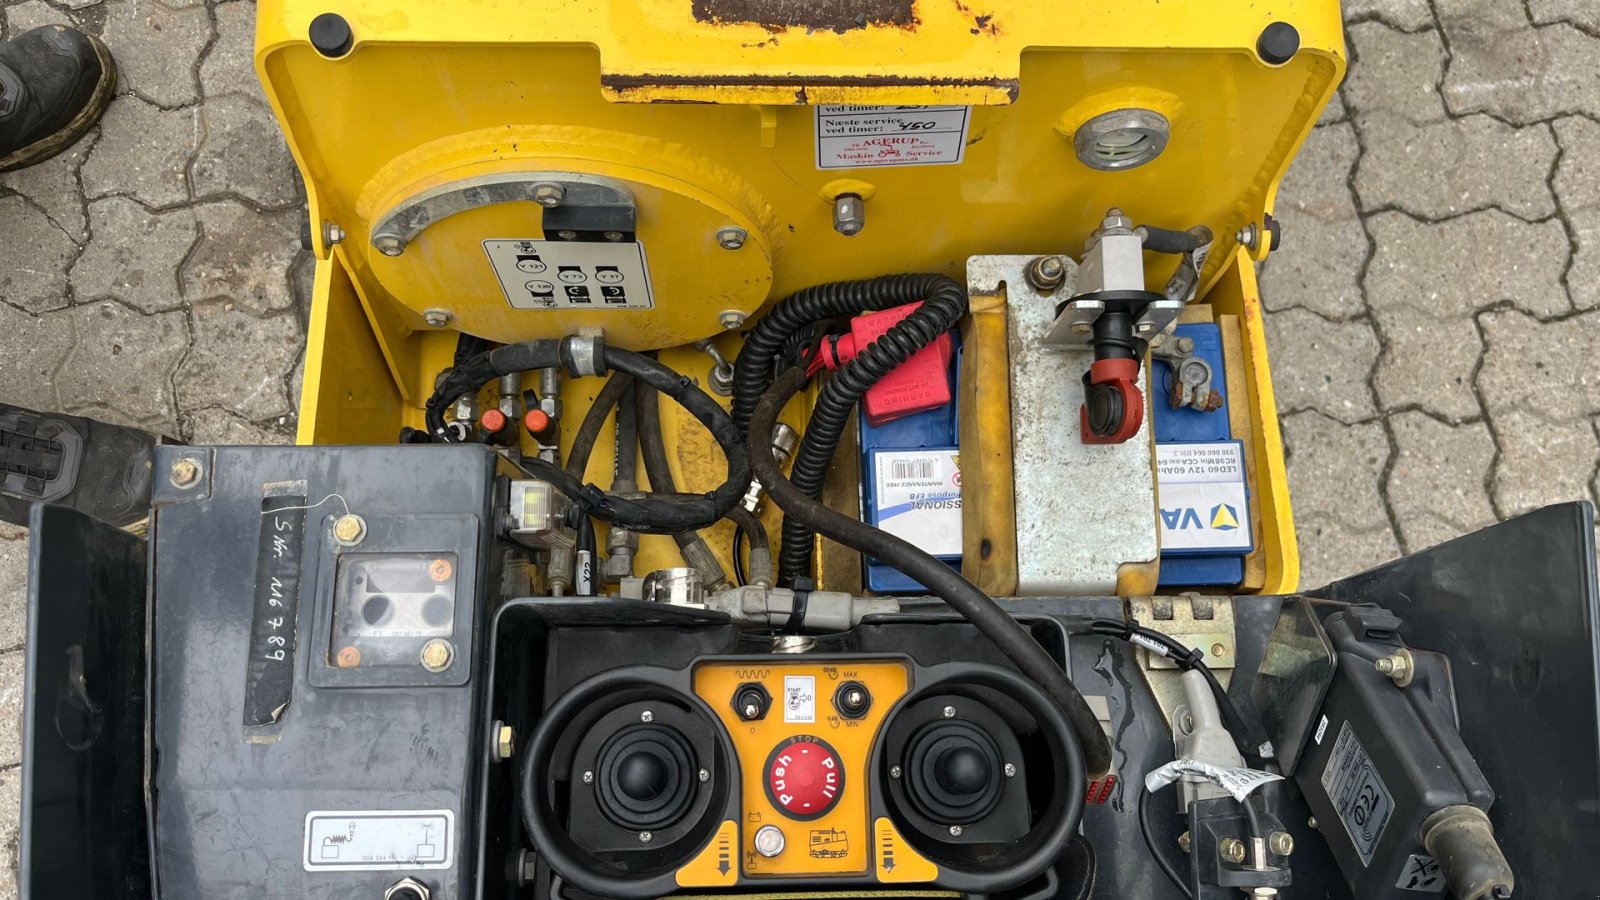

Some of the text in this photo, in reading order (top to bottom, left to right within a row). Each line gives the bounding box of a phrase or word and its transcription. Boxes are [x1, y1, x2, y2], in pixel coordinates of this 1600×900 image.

[825, 116, 903, 127] Næste service
[899, 121, 936, 131] 450
[863, 137, 920, 147] AGERUP
[836, 152, 874, 160] Maskin
[884, 391, 932, 405] WARNING
[790, 736, 819, 744] STOP
[775, 755, 793, 805] Push
[821, 757, 836, 798] Pull
